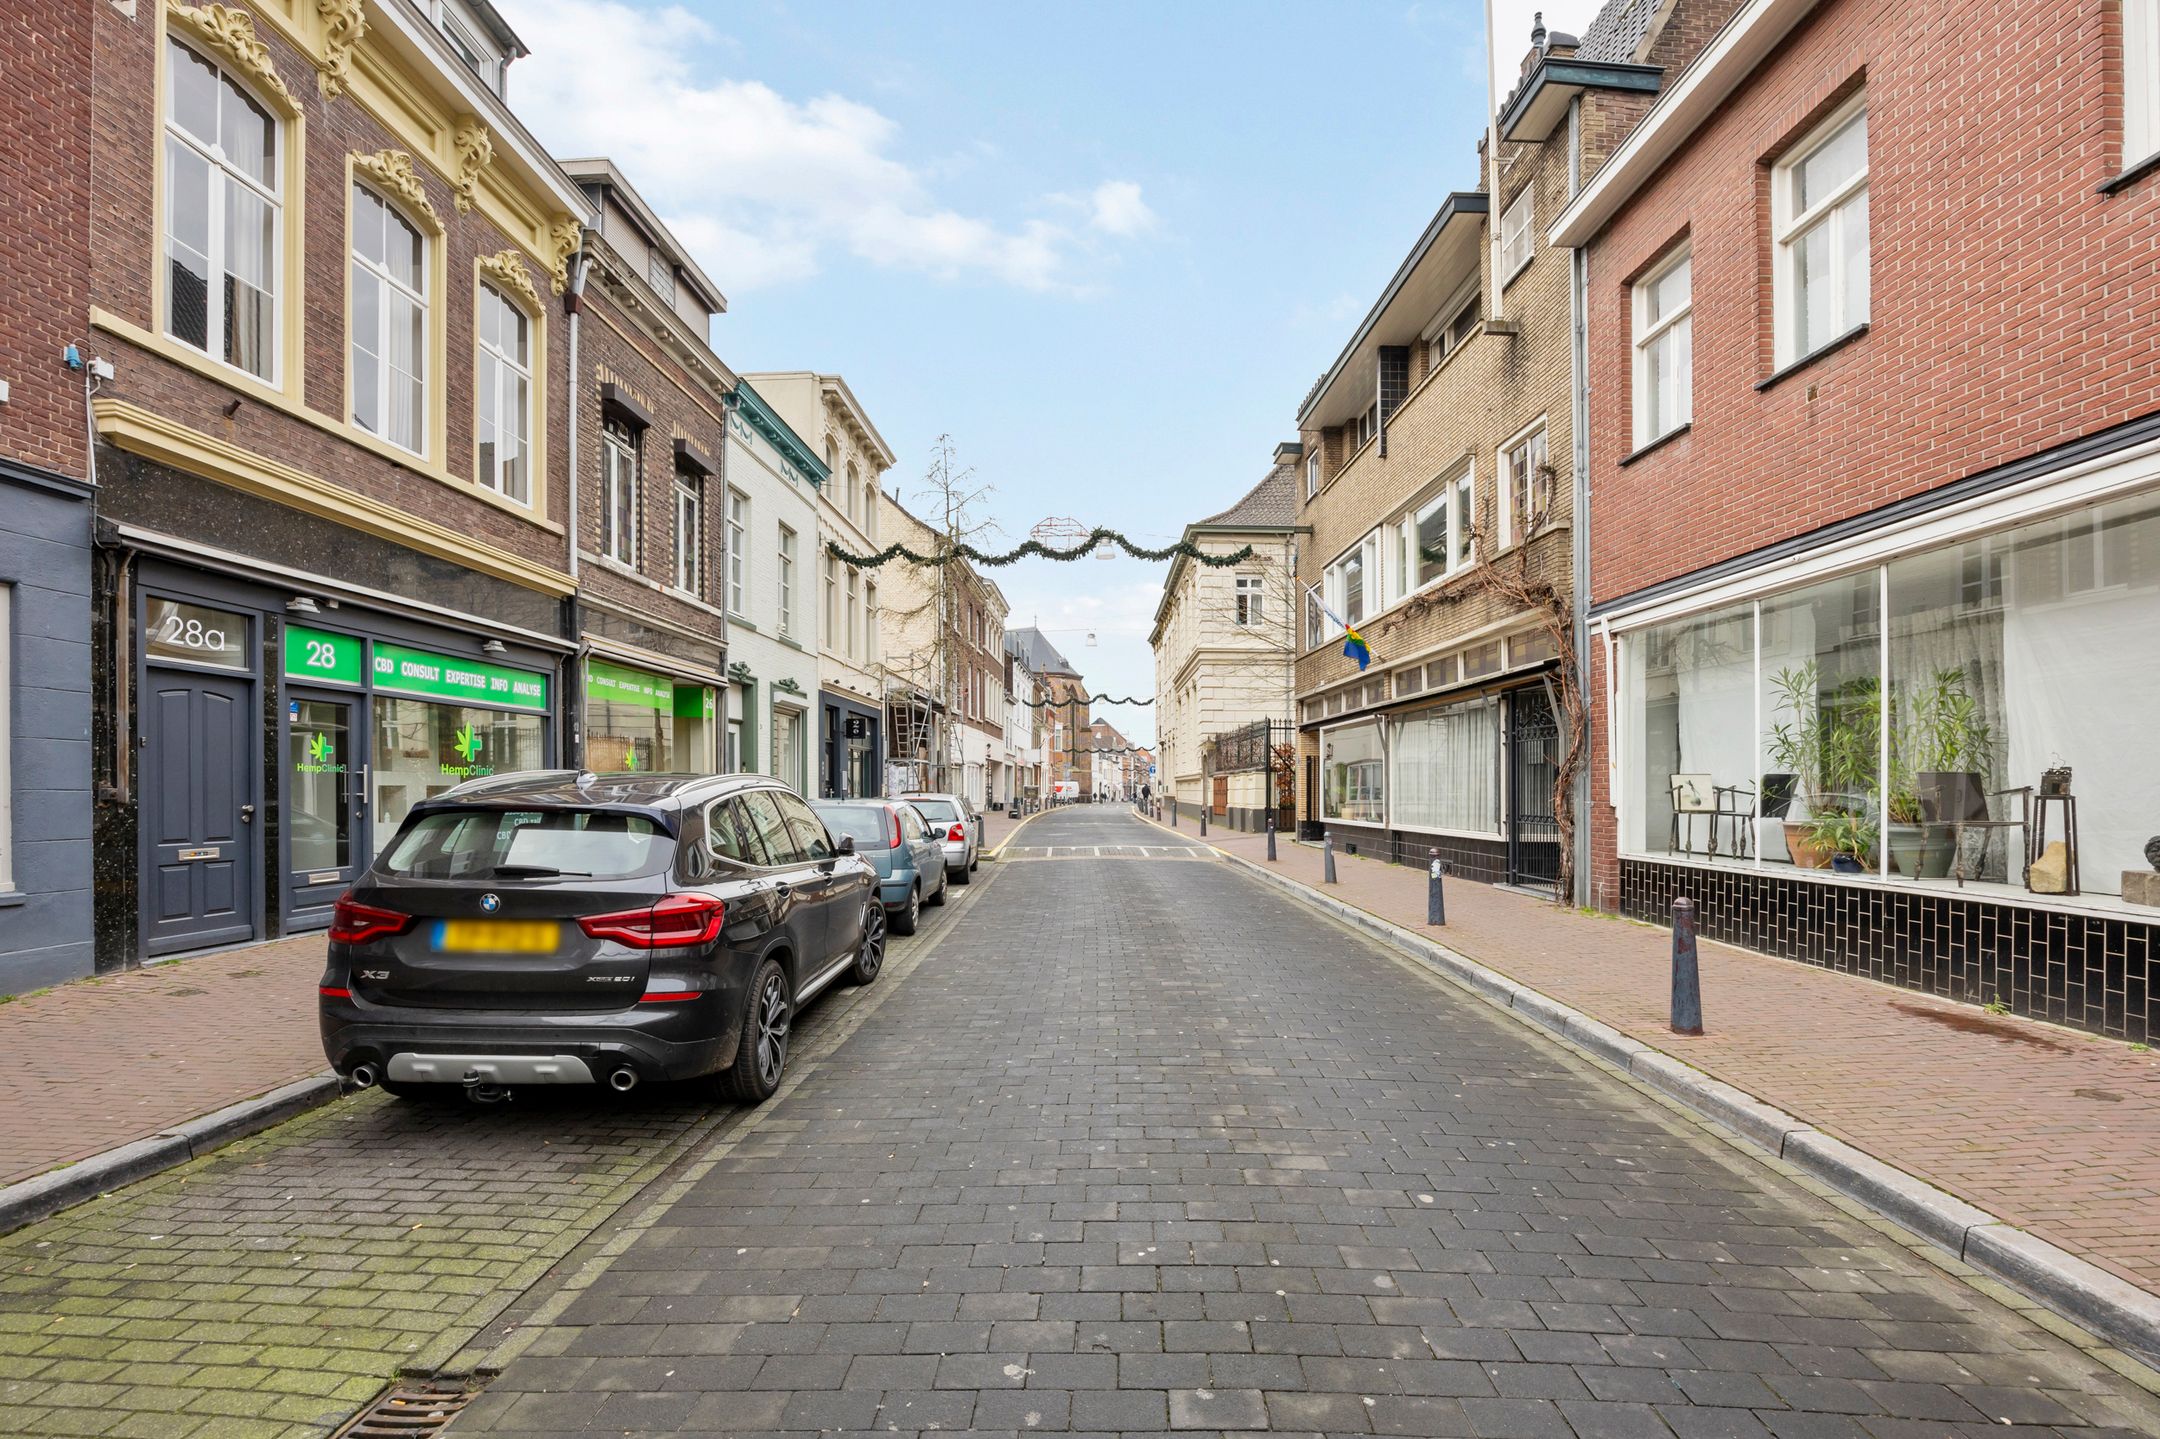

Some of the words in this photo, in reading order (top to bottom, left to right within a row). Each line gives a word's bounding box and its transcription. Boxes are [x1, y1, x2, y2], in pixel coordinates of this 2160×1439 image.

[166, 616, 225, 651] 28a
[306, 641, 336, 669] 28
[375, 657, 394, 673] CBD
[402, 662, 440, 680] CONSULT
[446, 670, 486, 688] EXPERTISE
[491, 677, 508, 691] INFO
[513, 681, 541, 696] ANALYSE
[297, 763, 345, 774] HempClinic
[441, 763, 495, 778] HempClinic
[360, 970, 390, 979] X3
